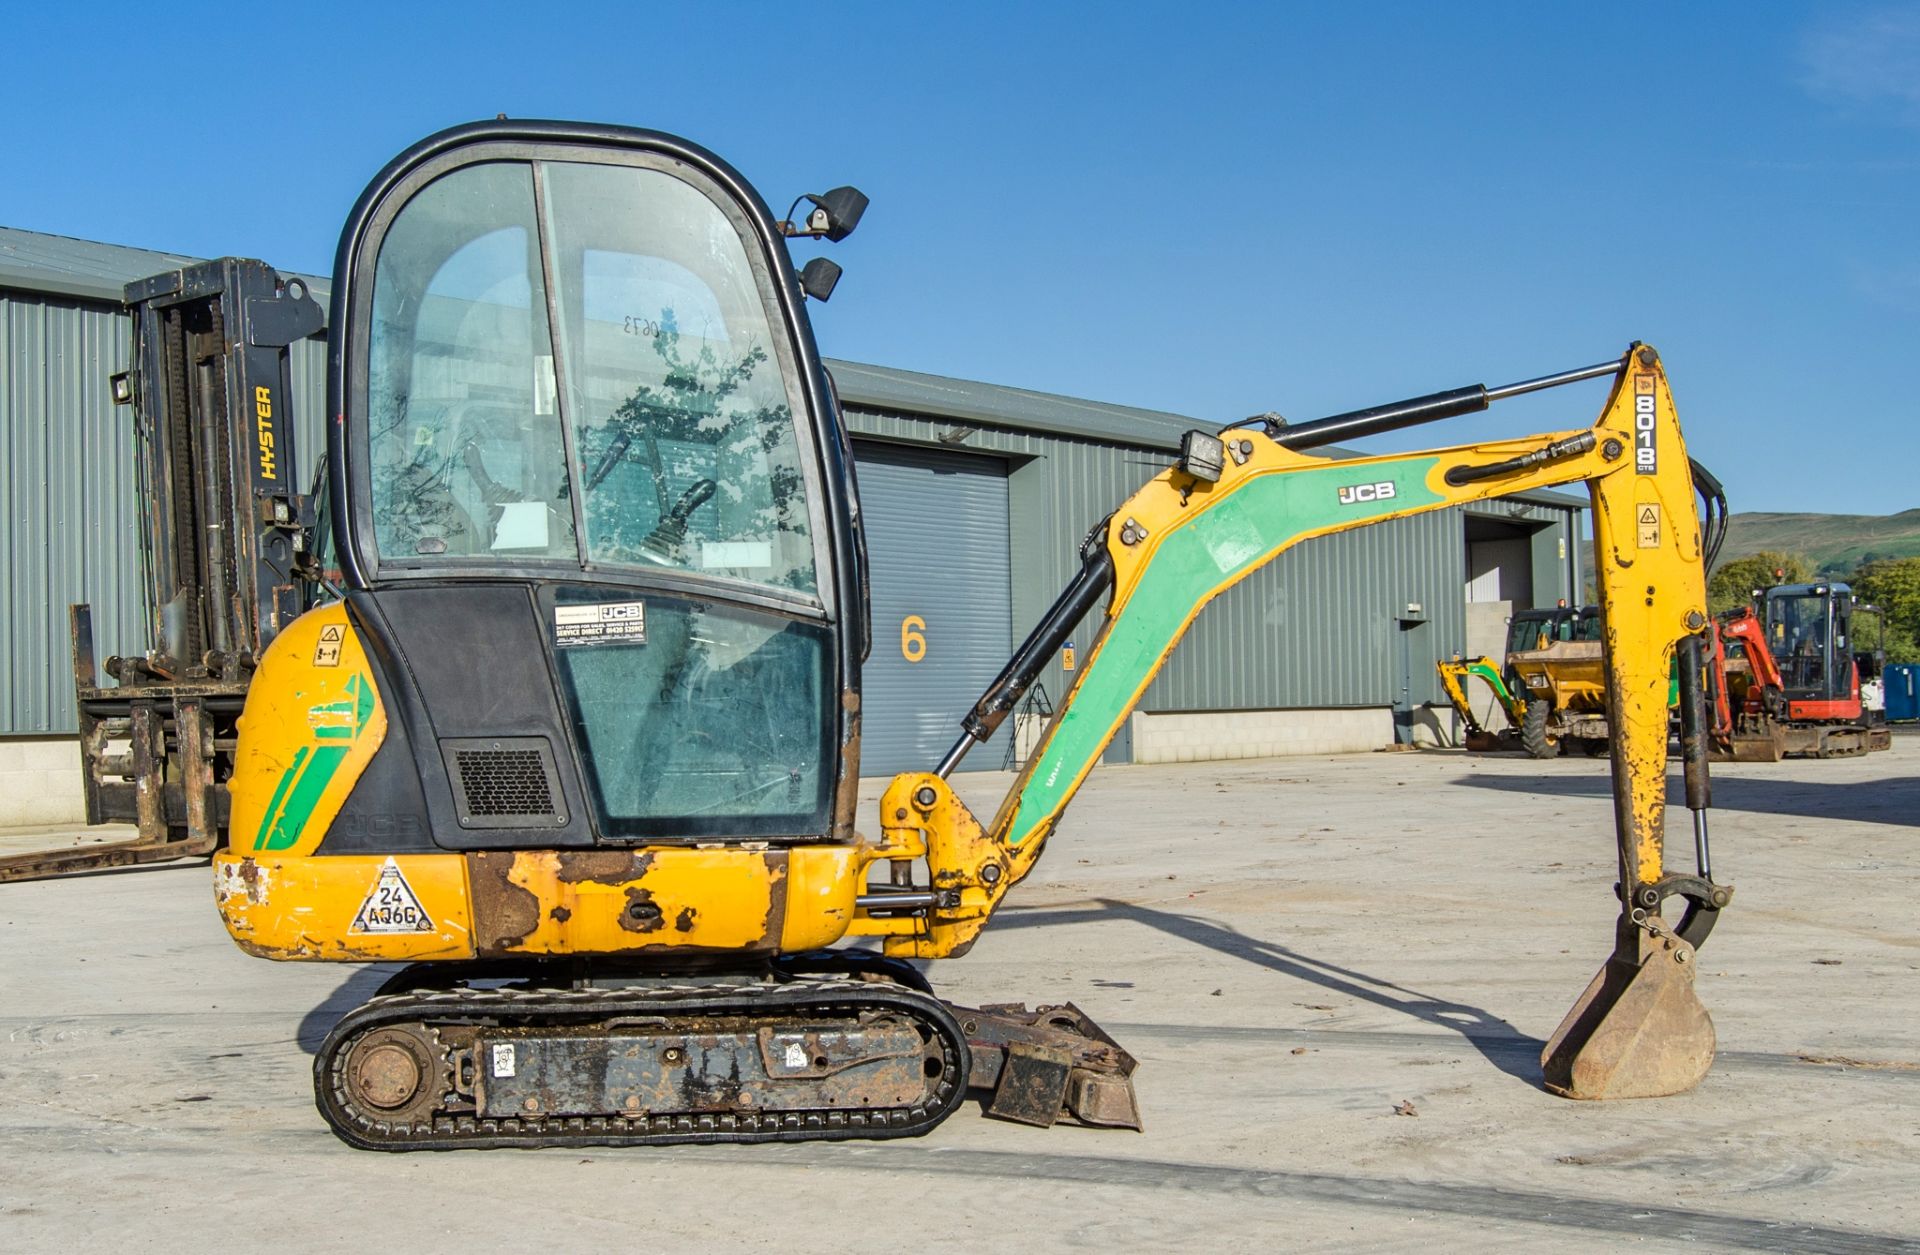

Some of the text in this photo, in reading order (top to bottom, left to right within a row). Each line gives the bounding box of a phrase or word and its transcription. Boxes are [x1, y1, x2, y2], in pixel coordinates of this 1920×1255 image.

[255, 386, 277, 480] HYSTER
[1636, 395, 1655, 465] 8018
[1339, 482, 1396, 504] JCB
[603, 606, 639, 619] JCB
[556, 629, 580, 637] SERVICE
[902, 615, 926, 662] 6
[380, 887, 402, 905] 24
[369, 906, 416, 925] AQ6G
